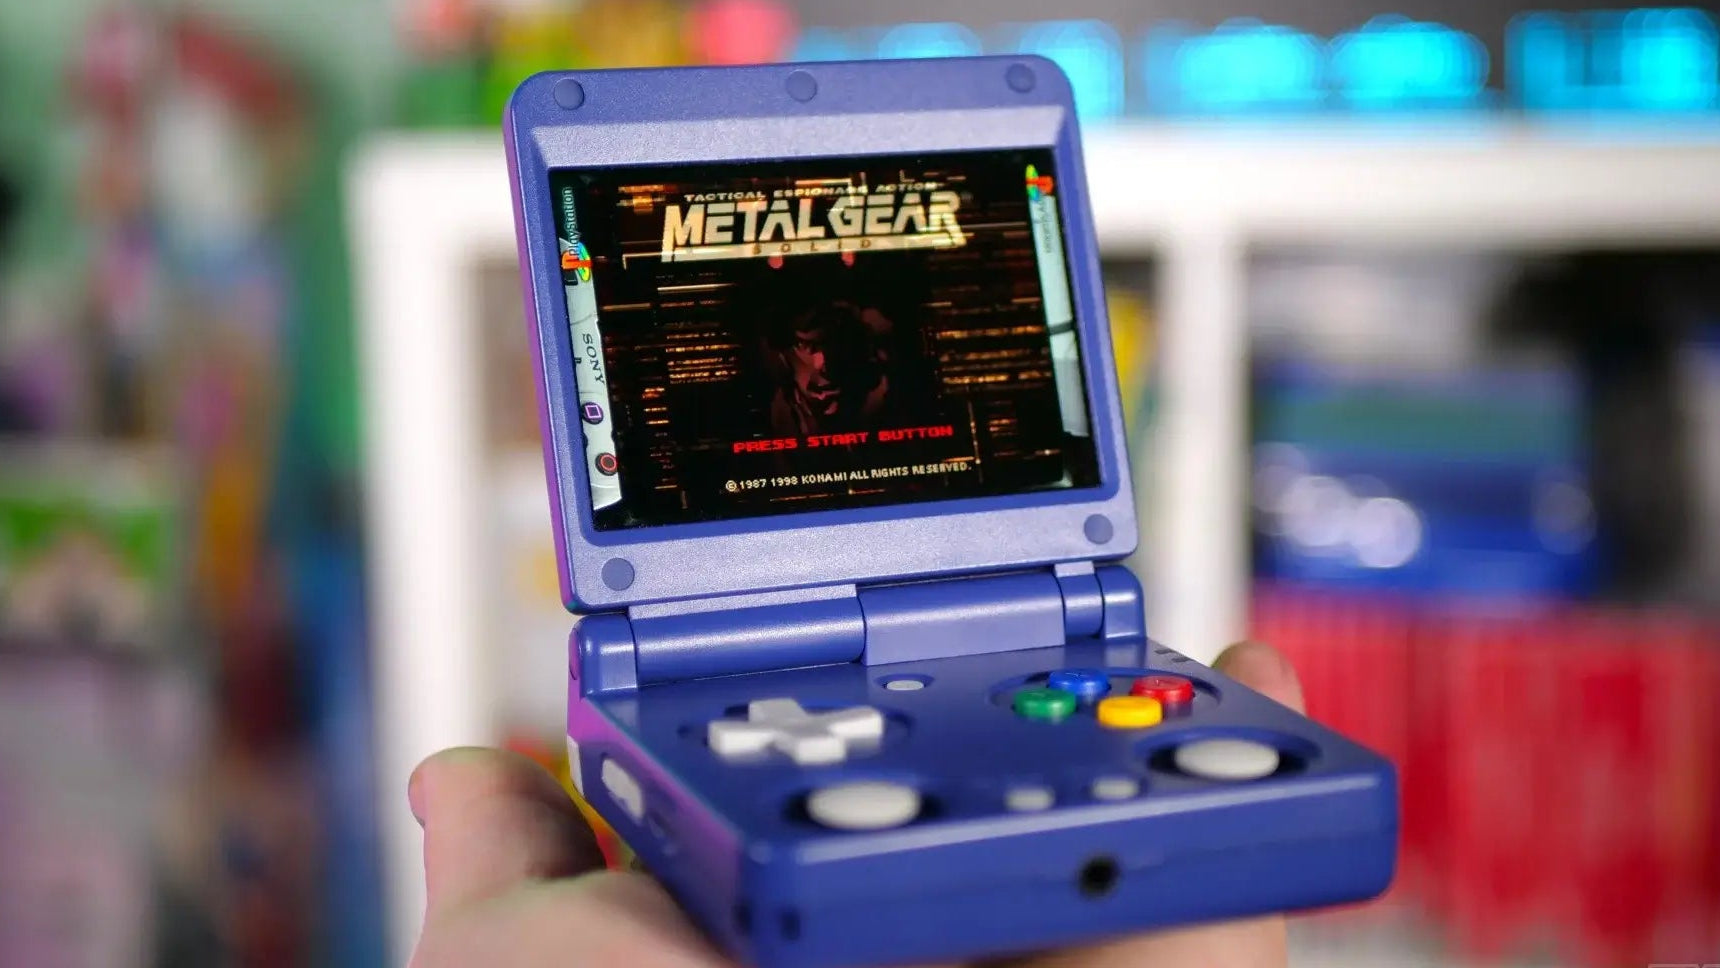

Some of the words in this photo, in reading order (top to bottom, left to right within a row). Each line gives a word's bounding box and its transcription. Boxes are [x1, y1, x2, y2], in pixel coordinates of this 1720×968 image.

[684, 191, 766, 202] TACTICAL
[661, 198, 825, 255] METAL
[827, 190, 966, 244] GEAR
[752, 239, 871, 254] SOLID
[582, 333, 606, 385] SONY
[733, 438, 798, 453] PRESS
[807, 432, 869, 447] START
[878, 425, 953, 442] BUTTON
[771, 476, 798, 487] 1998
[801, 471, 847, 484] KONAMI
[849, 470, 869, 480] ALL
[871, 466, 909, 478] RIGHTS
